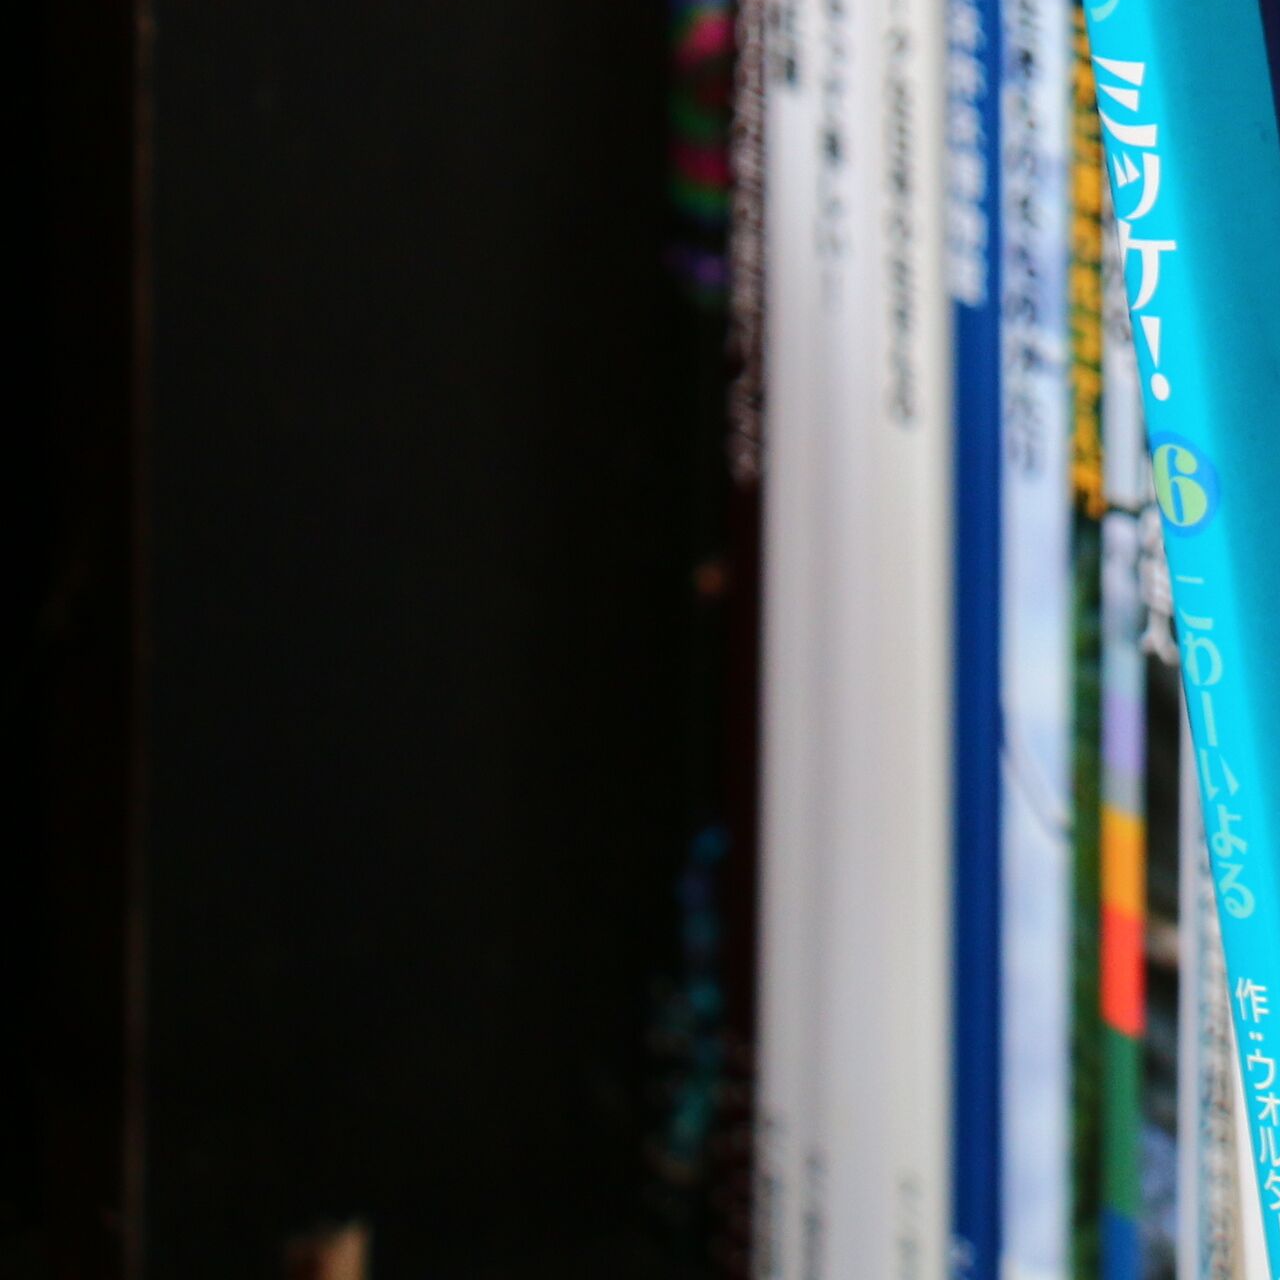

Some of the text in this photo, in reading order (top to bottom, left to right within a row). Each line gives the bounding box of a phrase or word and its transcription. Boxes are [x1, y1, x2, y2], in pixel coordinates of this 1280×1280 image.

[1175, 574, 1256, 919] こわーいよる
